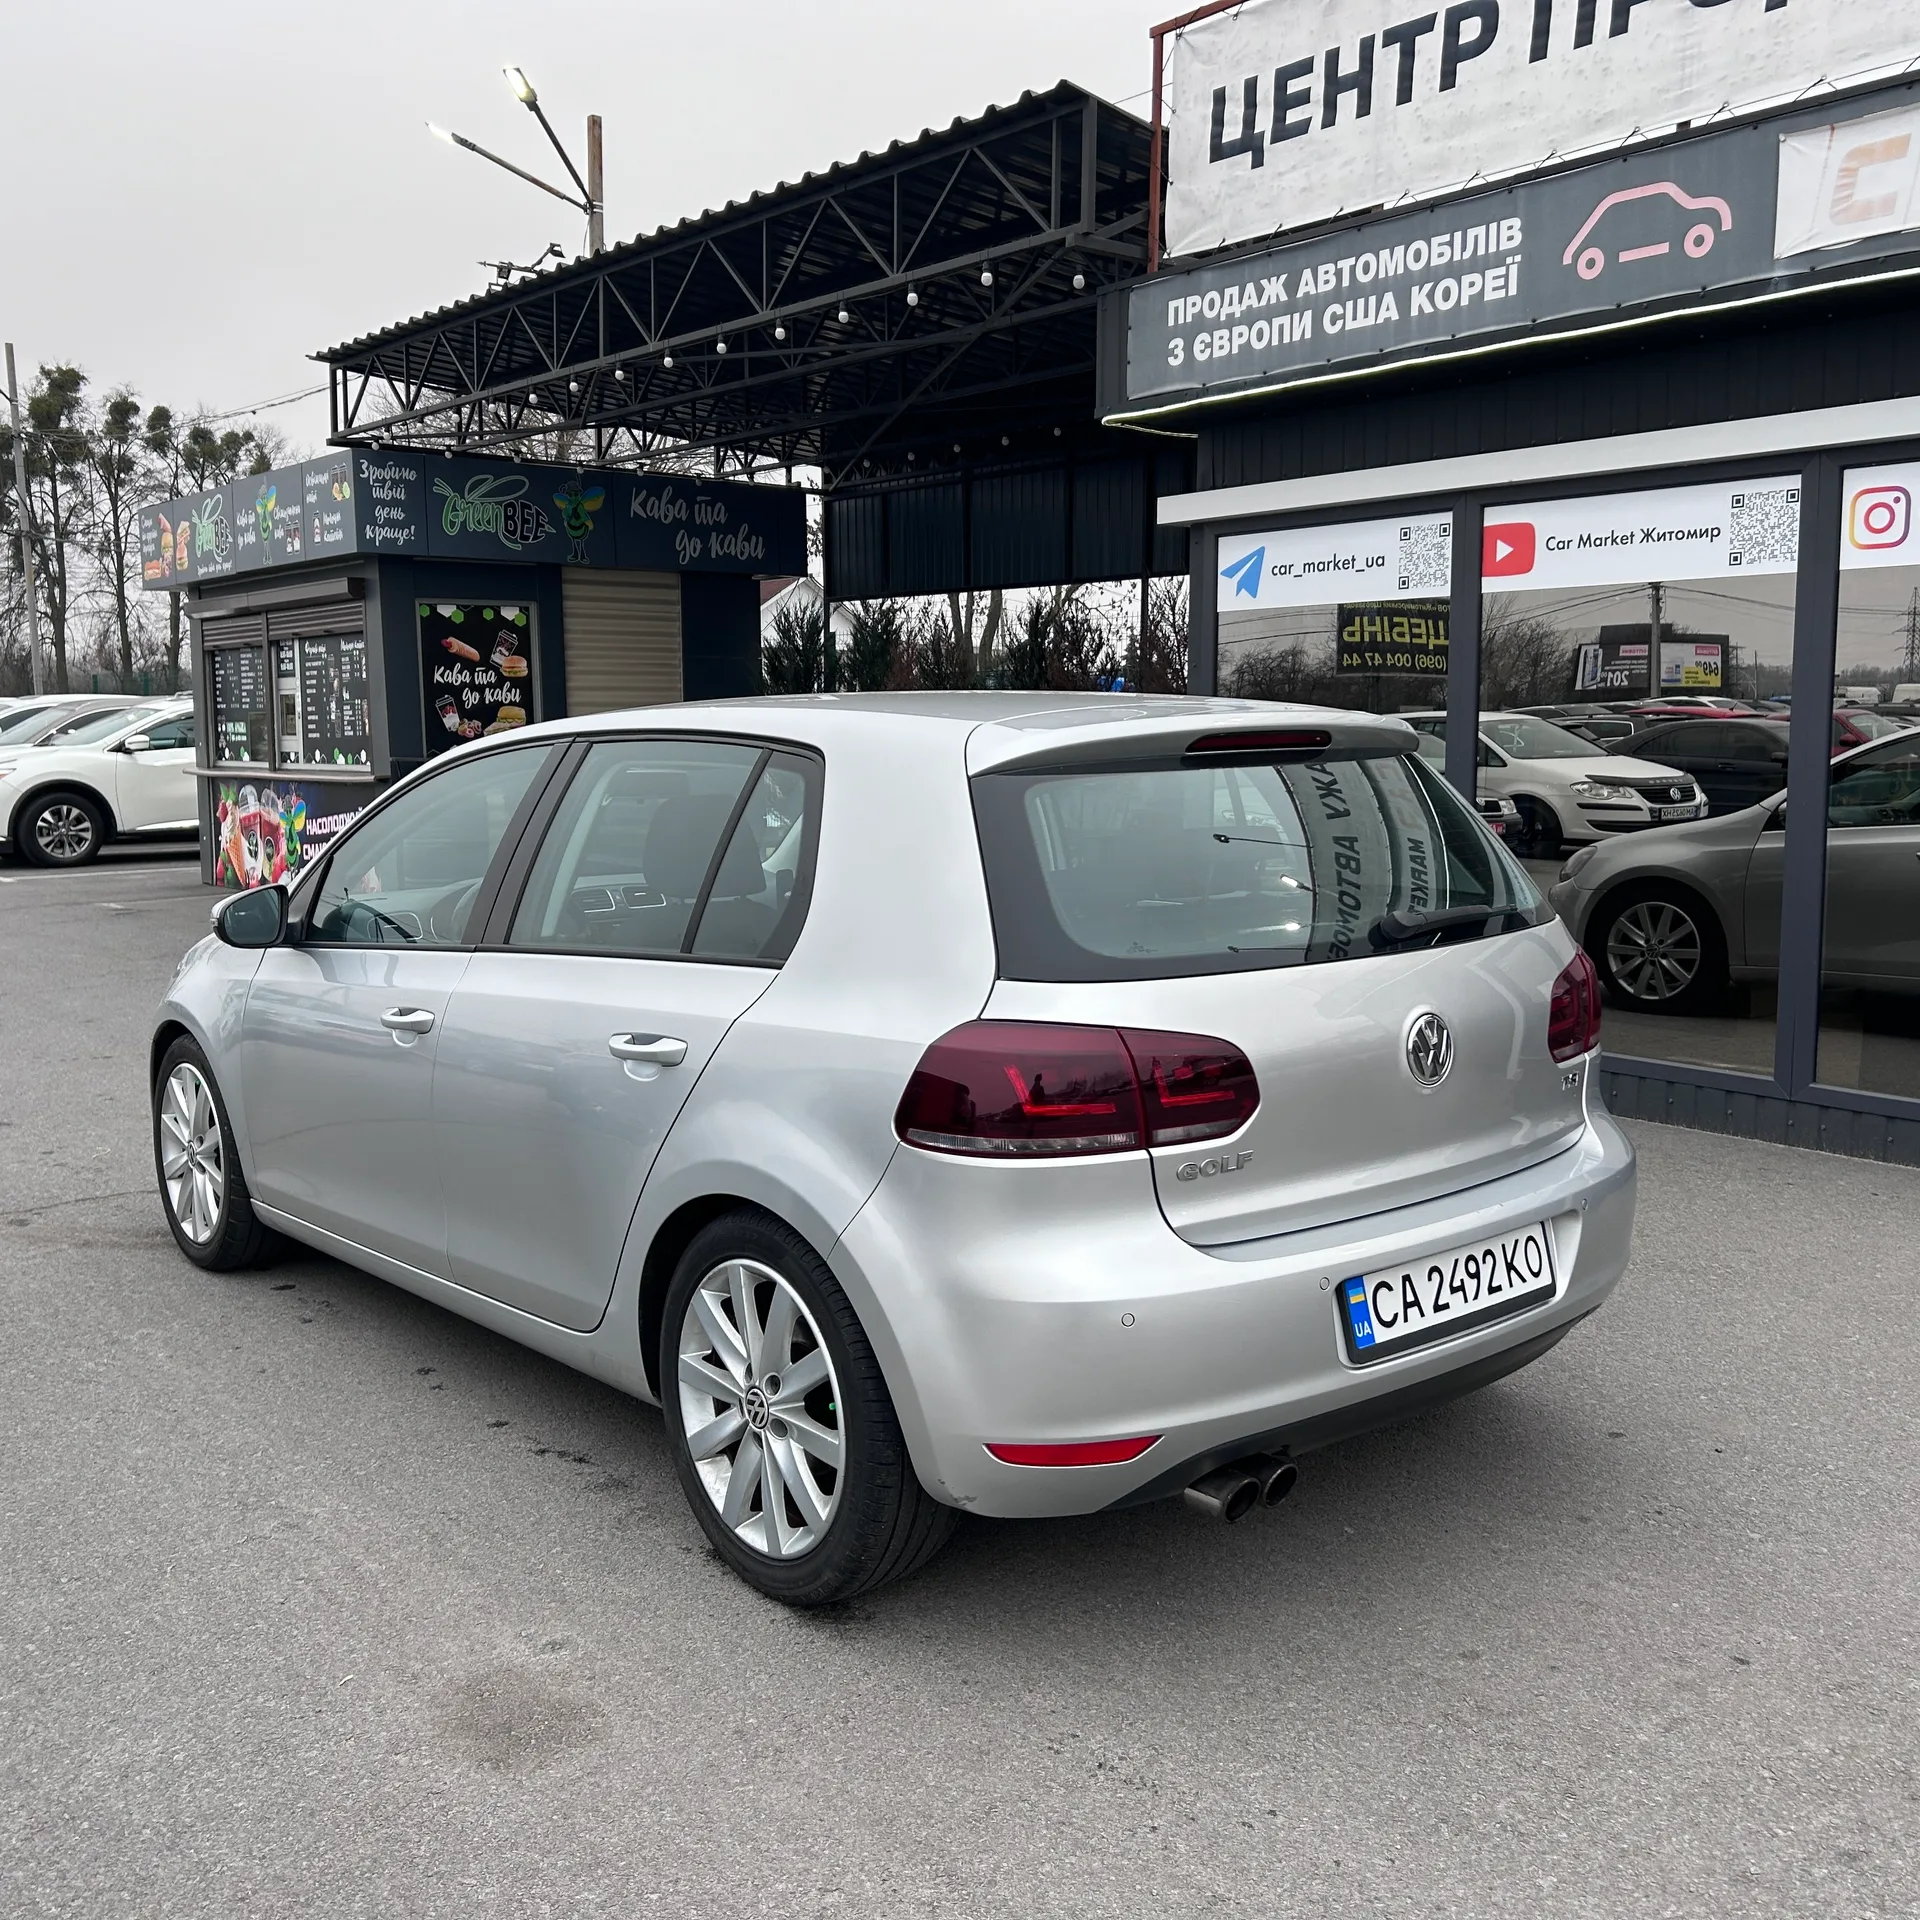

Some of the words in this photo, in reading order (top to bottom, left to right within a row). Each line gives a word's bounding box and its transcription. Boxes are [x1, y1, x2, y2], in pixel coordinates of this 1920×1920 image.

[1209, 0, 1499, 170] ЦЕНТР
[1168, 274, 1288, 326] ПРОДАЖ
[1296, 217, 1522, 298] АВТОМОБІЛІВ
[1167, 337, 1184, 367] З
[1193, 310, 1312, 362] ЄВРОПИ
[1322, 292, 1399, 335] США
[1411, 255, 1522, 317] КОРЕЇ
[359, 459, 418, 486] Зробимо
[371, 482, 406, 501] твій
[374, 504, 406, 524] день
[630, 485, 690, 525] Кава
[694, 496, 728, 526] та
[365, 525, 416, 547] краще!
[675, 529, 703, 565] до
[708, 523, 766, 561] кави
[1545, 536, 1573, 551] Car
[1577, 530, 1635, 549] Market
[1639, 526, 1721, 544] Житомир
[1271, 553, 1385, 579] car_market_ua
[434, 662, 472, 686] Кава
[474, 667, 497, 685] та
[462, 687, 480, 709] до
[484, 681, 521, 705] кави
[1176, 1149, 1254, 1182] GOLF
[1354, 1320, 1372, 1338] UA
